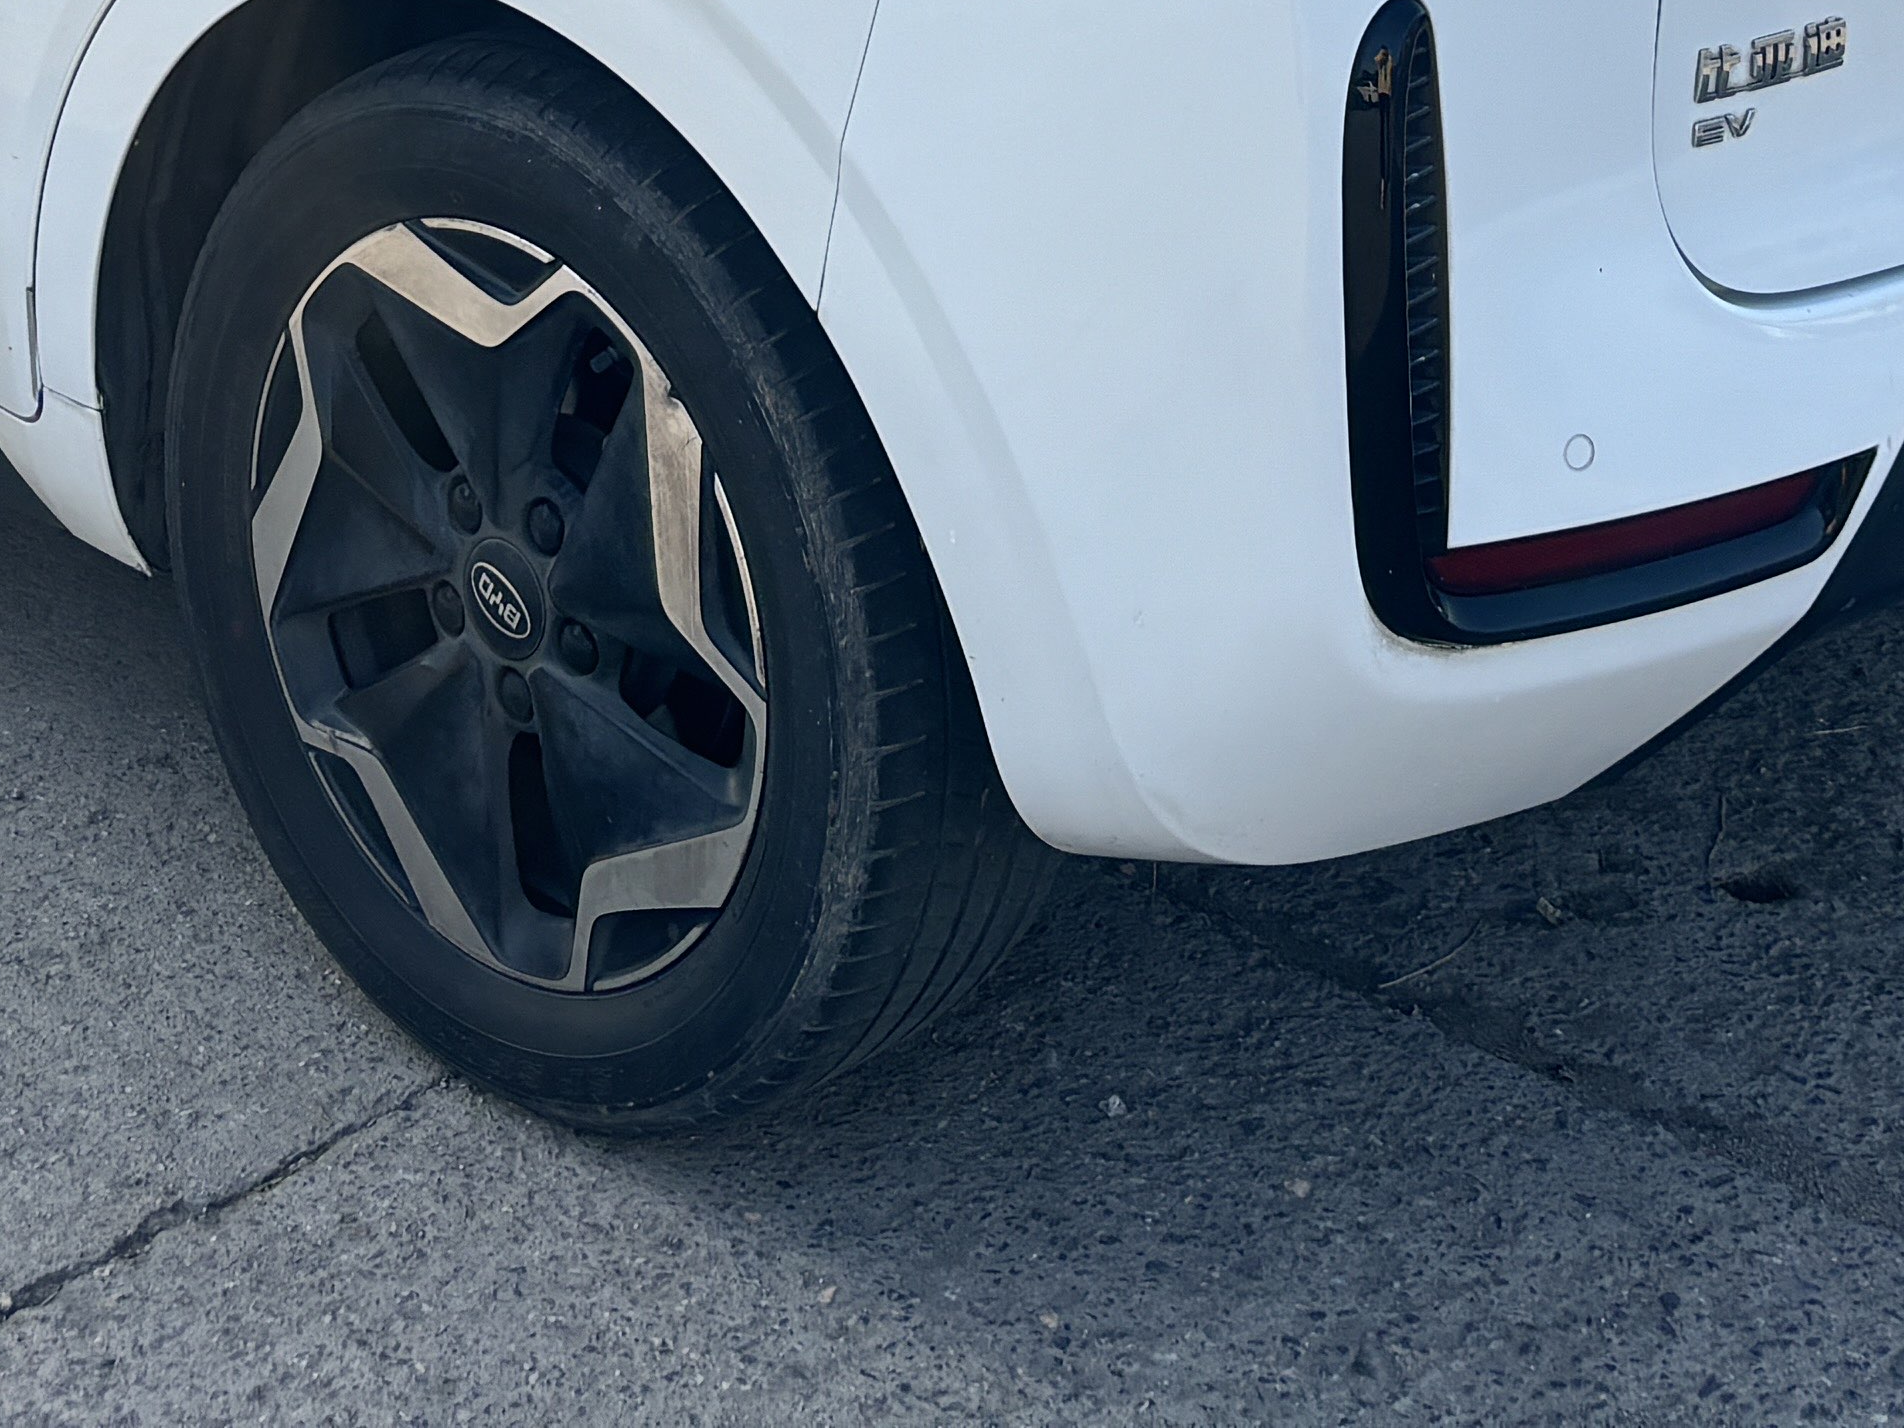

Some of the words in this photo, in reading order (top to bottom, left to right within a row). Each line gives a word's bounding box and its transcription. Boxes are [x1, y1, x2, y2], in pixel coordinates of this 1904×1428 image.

[1693, 15, 1847, 104] 比亚迪
[1691, 107, 1756, 148] EV
[478, 570, 522, 632] BYD
